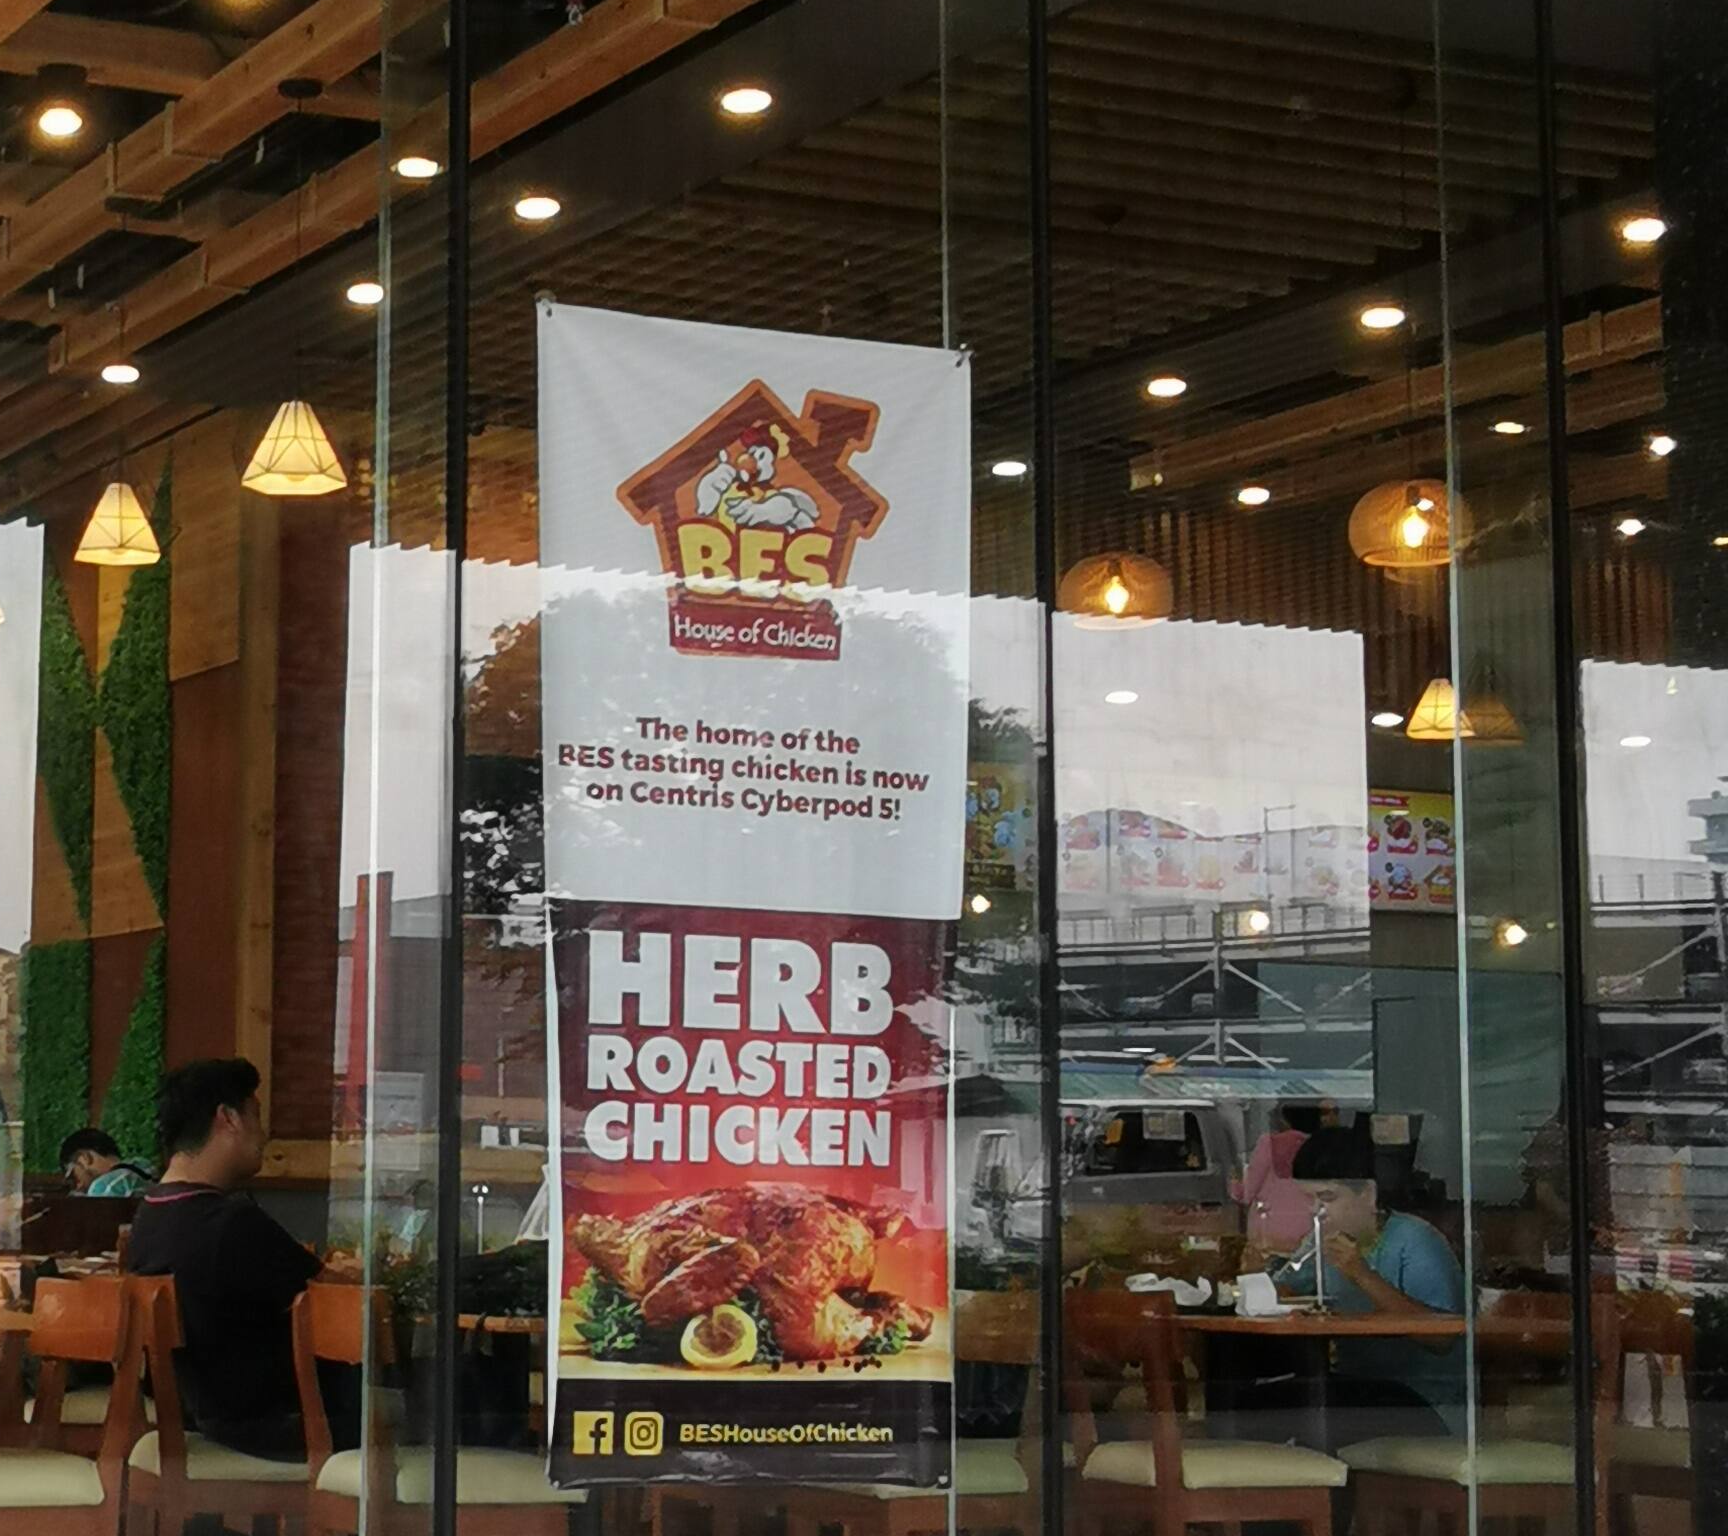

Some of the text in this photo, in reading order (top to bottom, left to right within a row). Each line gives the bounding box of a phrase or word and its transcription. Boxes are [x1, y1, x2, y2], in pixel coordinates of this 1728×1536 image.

[677, 521, 834, 603] BES
[673, 614, 837, 651] House of Chicken
[635, 716, 861, 755] The home of the
[558, 743, 930, 792] BES tasting chicken is now
[585, 780, 901, 822] on Centris Cyberpod 5!
[587, 930, 894, 1036] HERB
[586, 1035, 892, 1100] ROASTED
[583, 1101, 891, 1167] CHICKEN
[678, 1422, 894, 1444] BESHouseOfChicken
